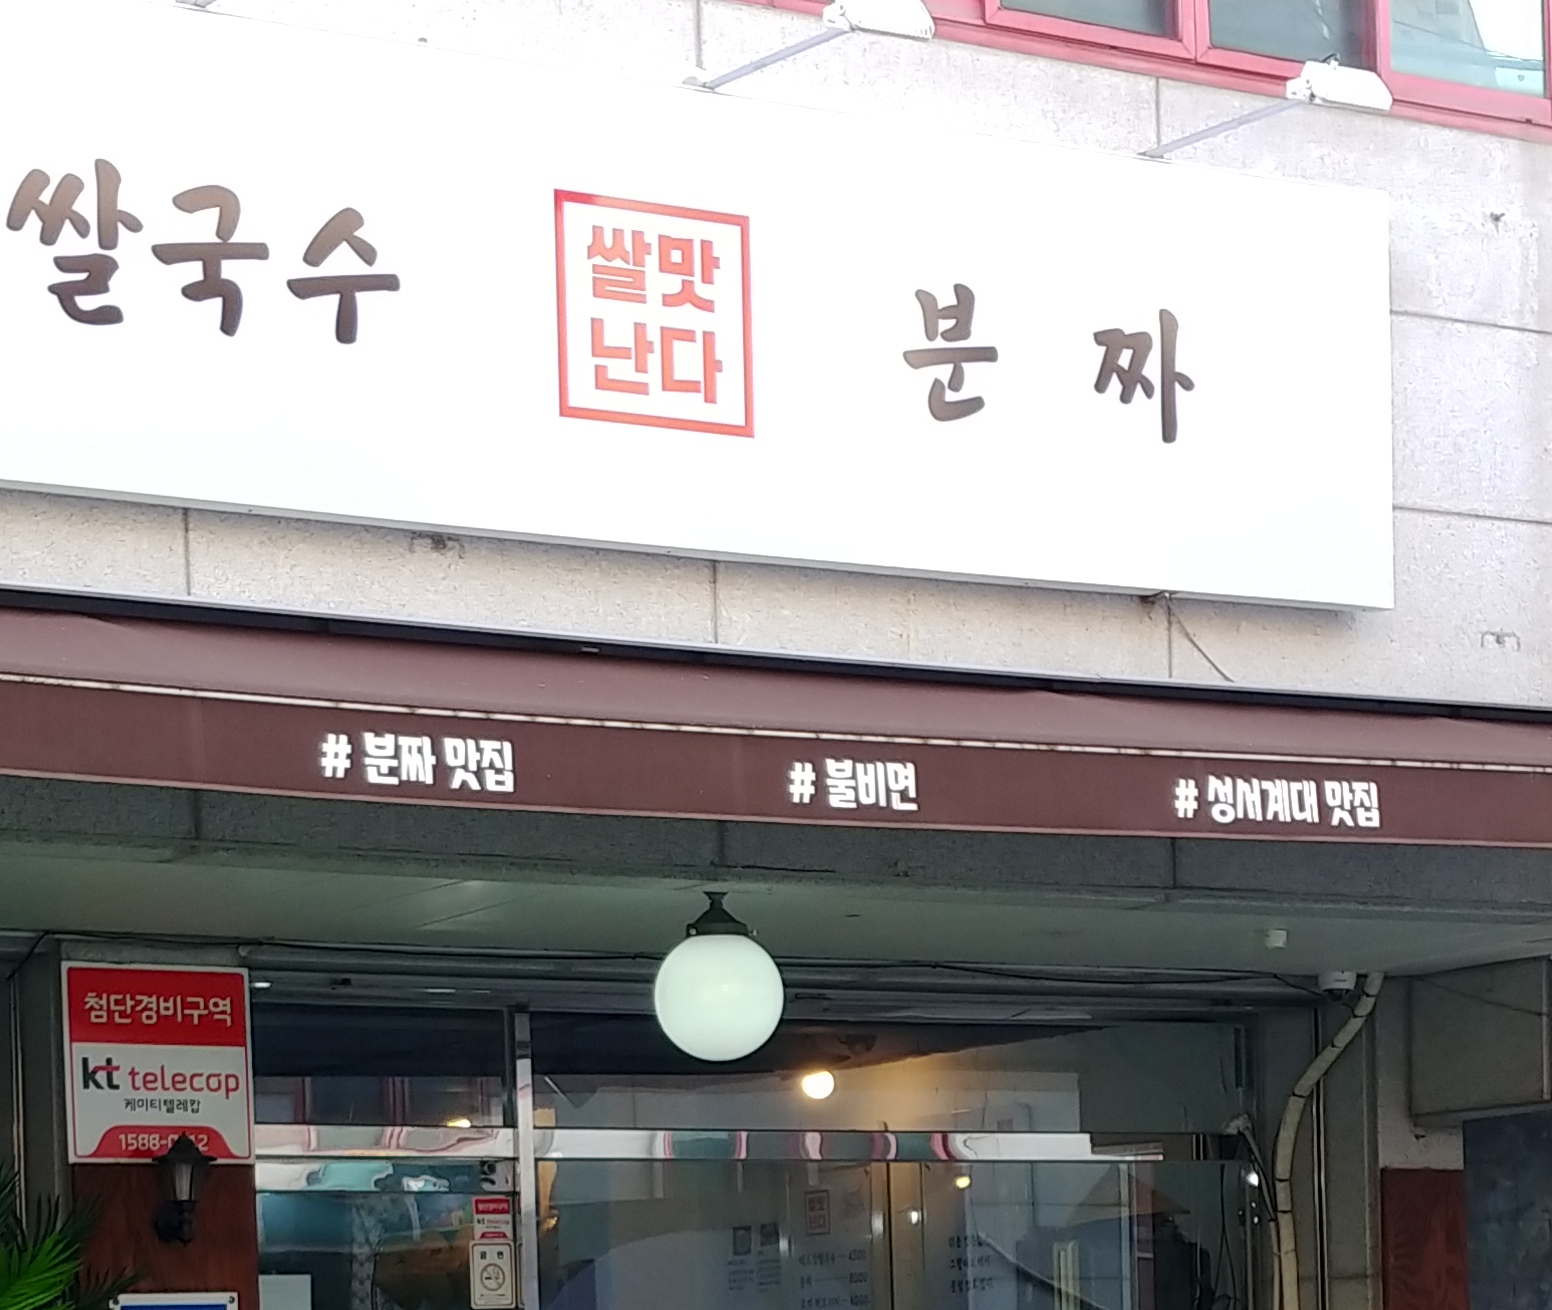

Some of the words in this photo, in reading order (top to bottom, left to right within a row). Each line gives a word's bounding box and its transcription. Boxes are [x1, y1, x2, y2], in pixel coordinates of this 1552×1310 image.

[5, 158, 401, 345] 쌀국수
[587, 225, 721, 313] 쌀맛
[590, 316, 724, 404] 난다
[363, 732, 437, 785] 분짜
[444, 737, 515, 792] 맛집
[825, 758, 918, 810] 불비면
[1207, 775, 1320, 824] 성서계대
[1324, 780, 1381, 828] 맛집
[84, 992, 232, 1027] 첨단경비구역
[81, 1057, 121, 1090] kt
[128, 1065, 240, 1100] telecop
[124, 1098, 201, 1114] 케이티텔레캅
